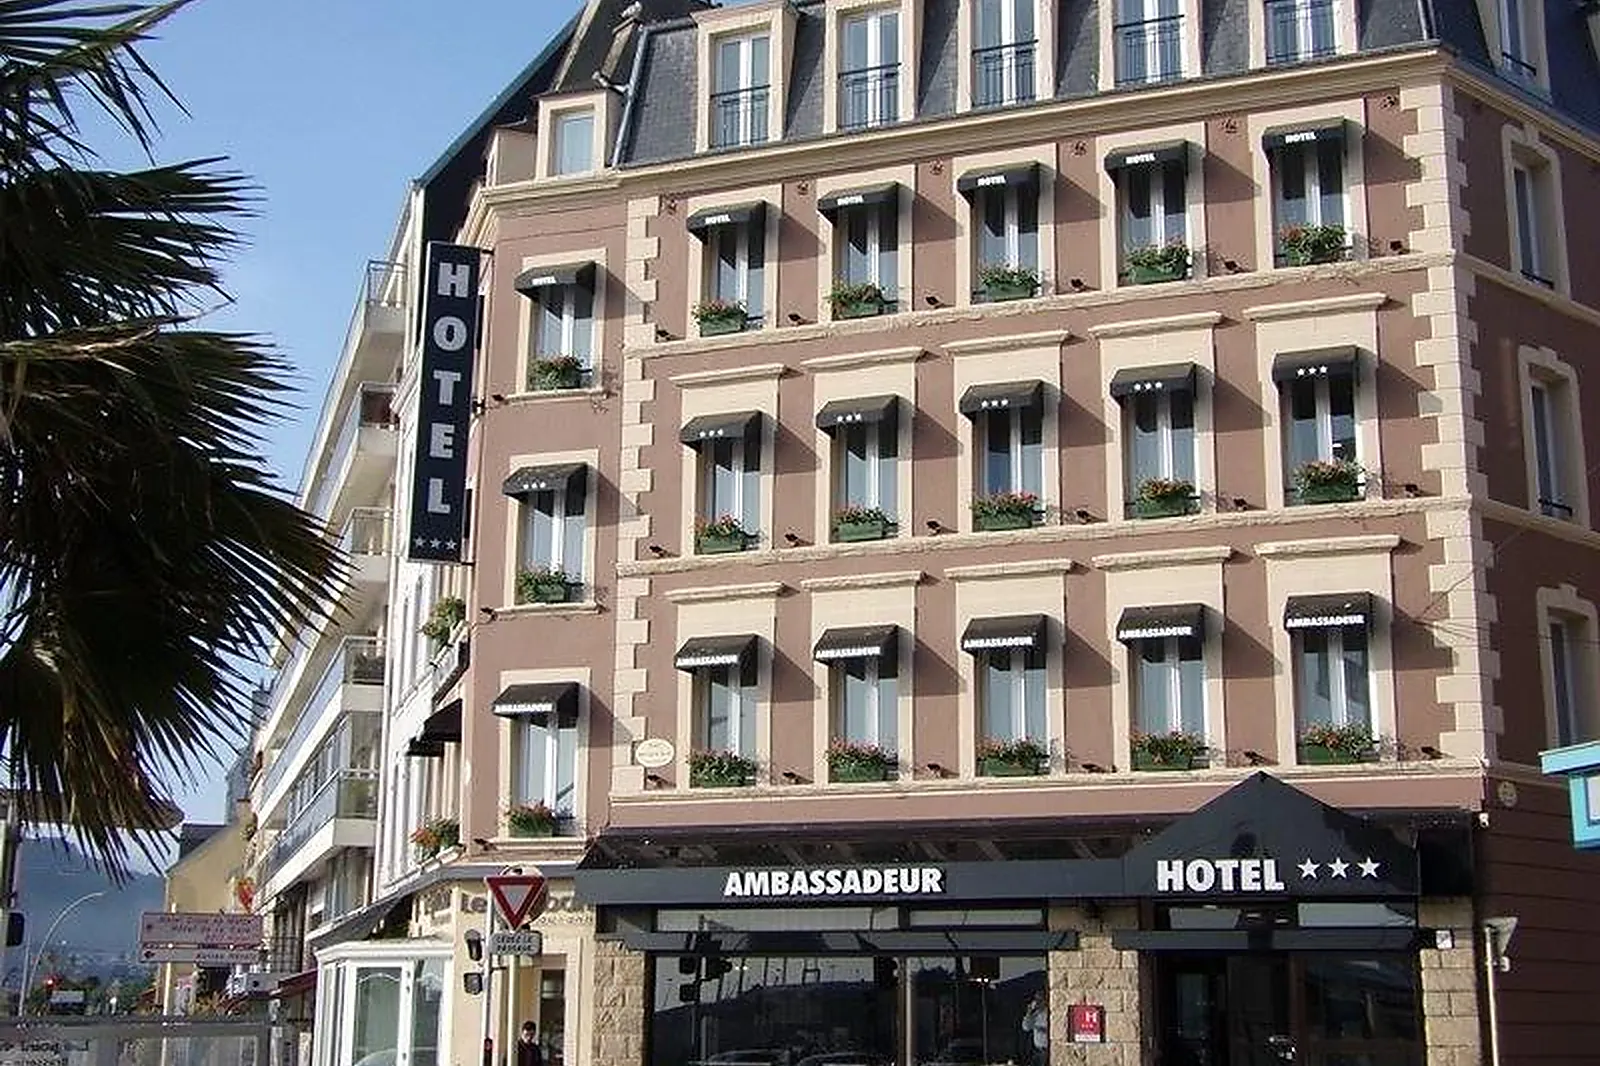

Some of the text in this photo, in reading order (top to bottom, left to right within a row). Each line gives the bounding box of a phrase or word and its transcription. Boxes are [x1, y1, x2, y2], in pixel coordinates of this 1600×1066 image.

[1284, 132, 1316, 144] HOTEL
[426, 261, 471, 514] HOTEL
[1285, 614, 1365, 628] AMBASSADEUR
[1118, 626, 1192, 639] AMBASSADEUR
[963, 636, 1033, 649] AMBASSADEUR
[815, 646, 881, 659] AMBASSADEUR
[675, 654, 739, 667] AMBASSADEUR
[494, 703, 554, 714] AMBASSADEUR
[1156, 858, 1286, 892] HOTEL
[723, 867, 944, 897] AMBASSADEUR
